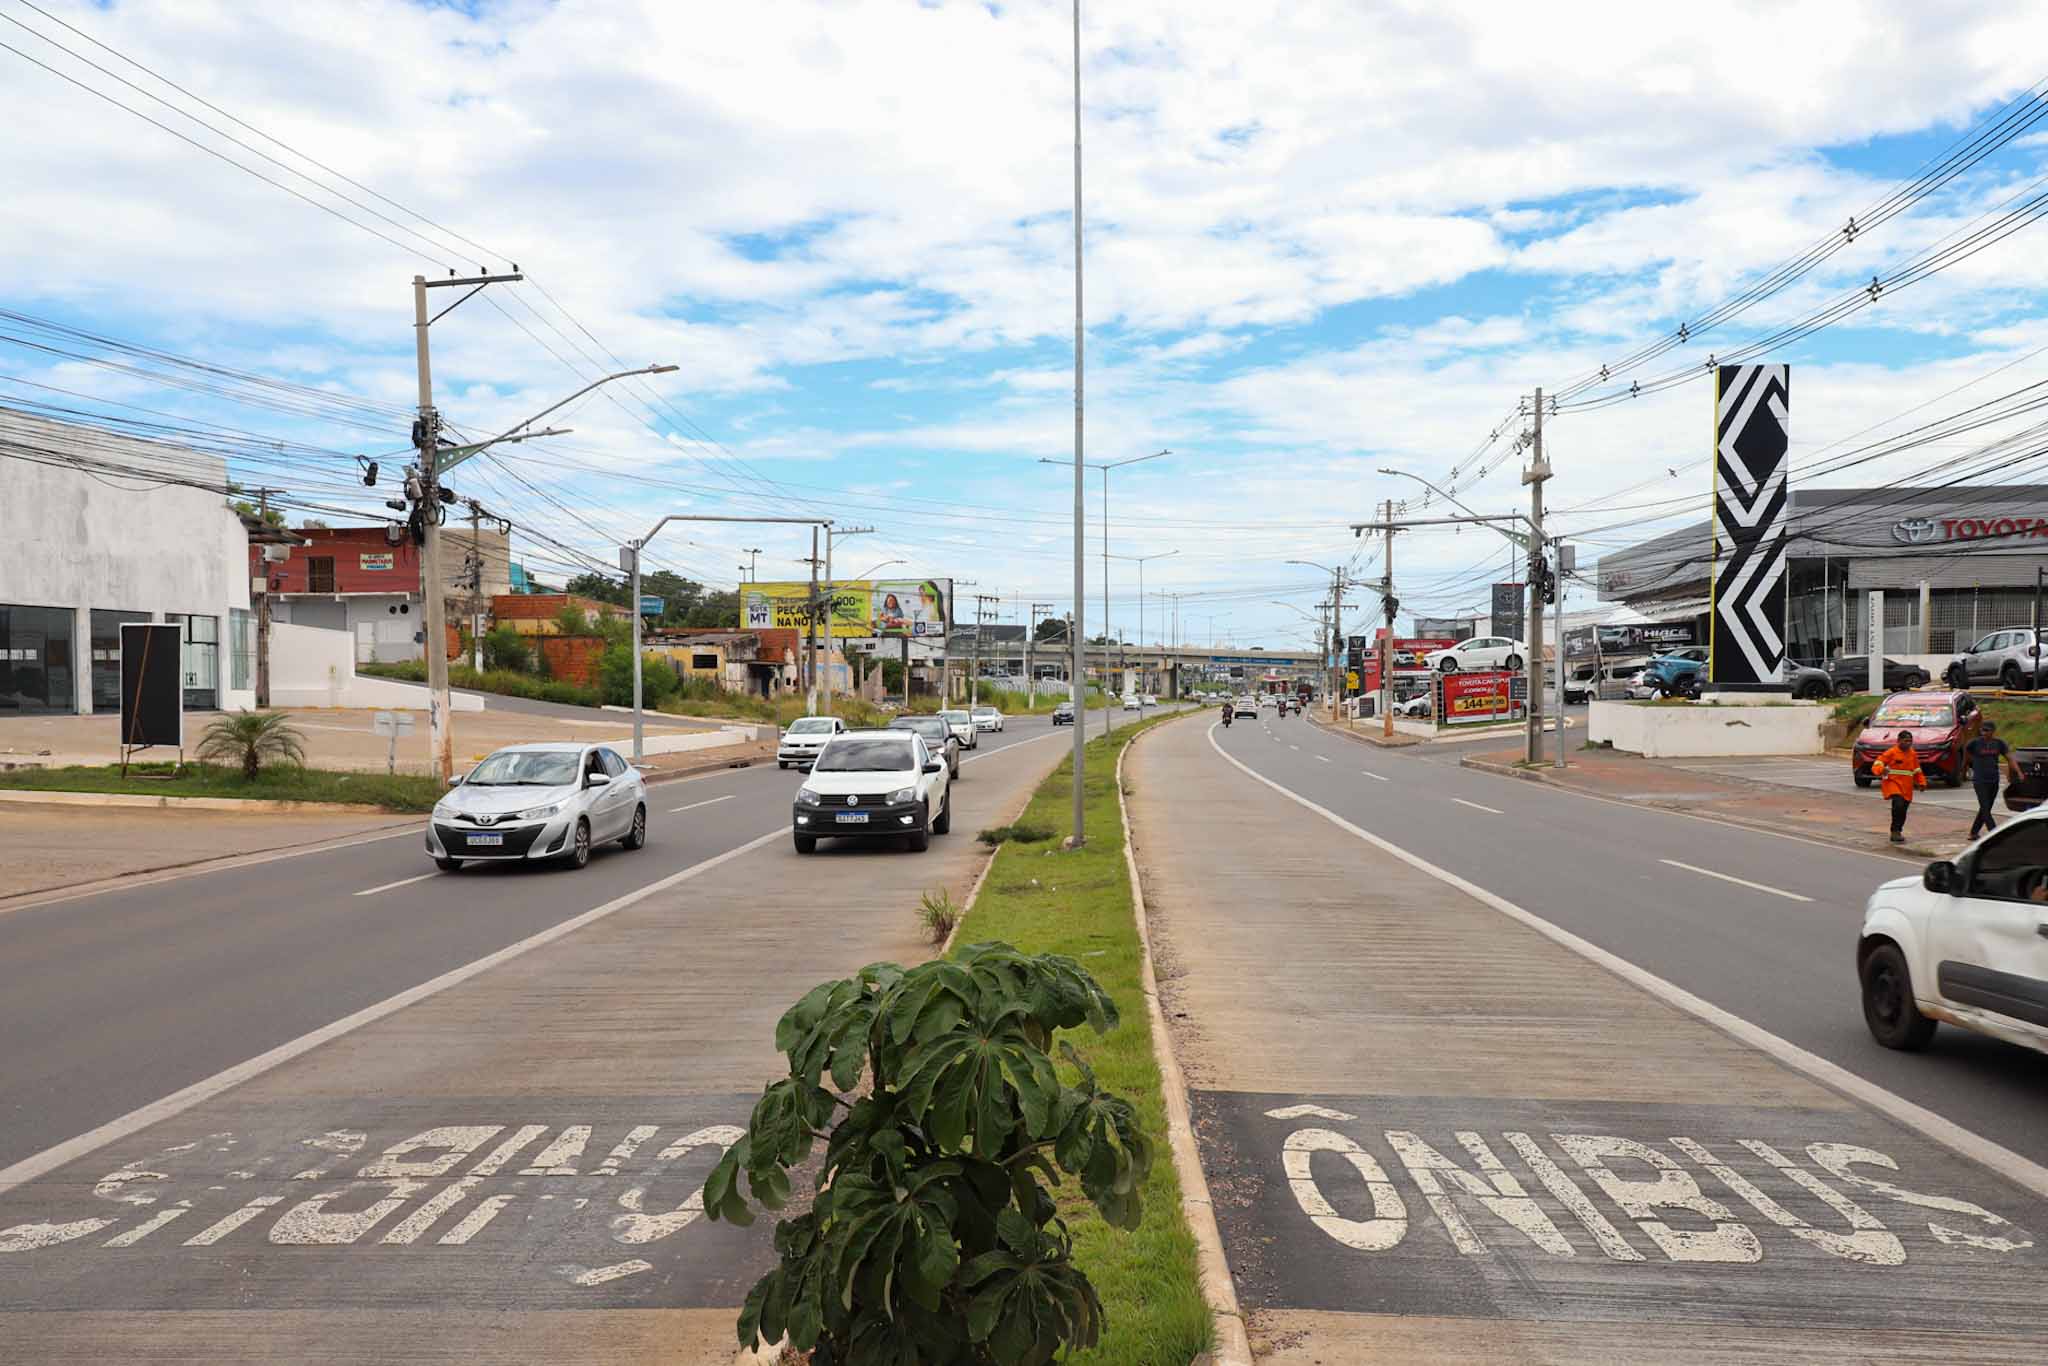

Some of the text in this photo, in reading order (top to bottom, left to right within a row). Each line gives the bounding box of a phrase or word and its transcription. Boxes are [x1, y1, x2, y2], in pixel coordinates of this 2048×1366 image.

[1942, 517, 2048, 540] TOYOTA
[750, 613, 768, 624] MT
[777, 617, 792, 627] NA
[1644, 628, 1689, 638] HIACE
[1264, 1104, 2035, 1266] ÔNIBUS
